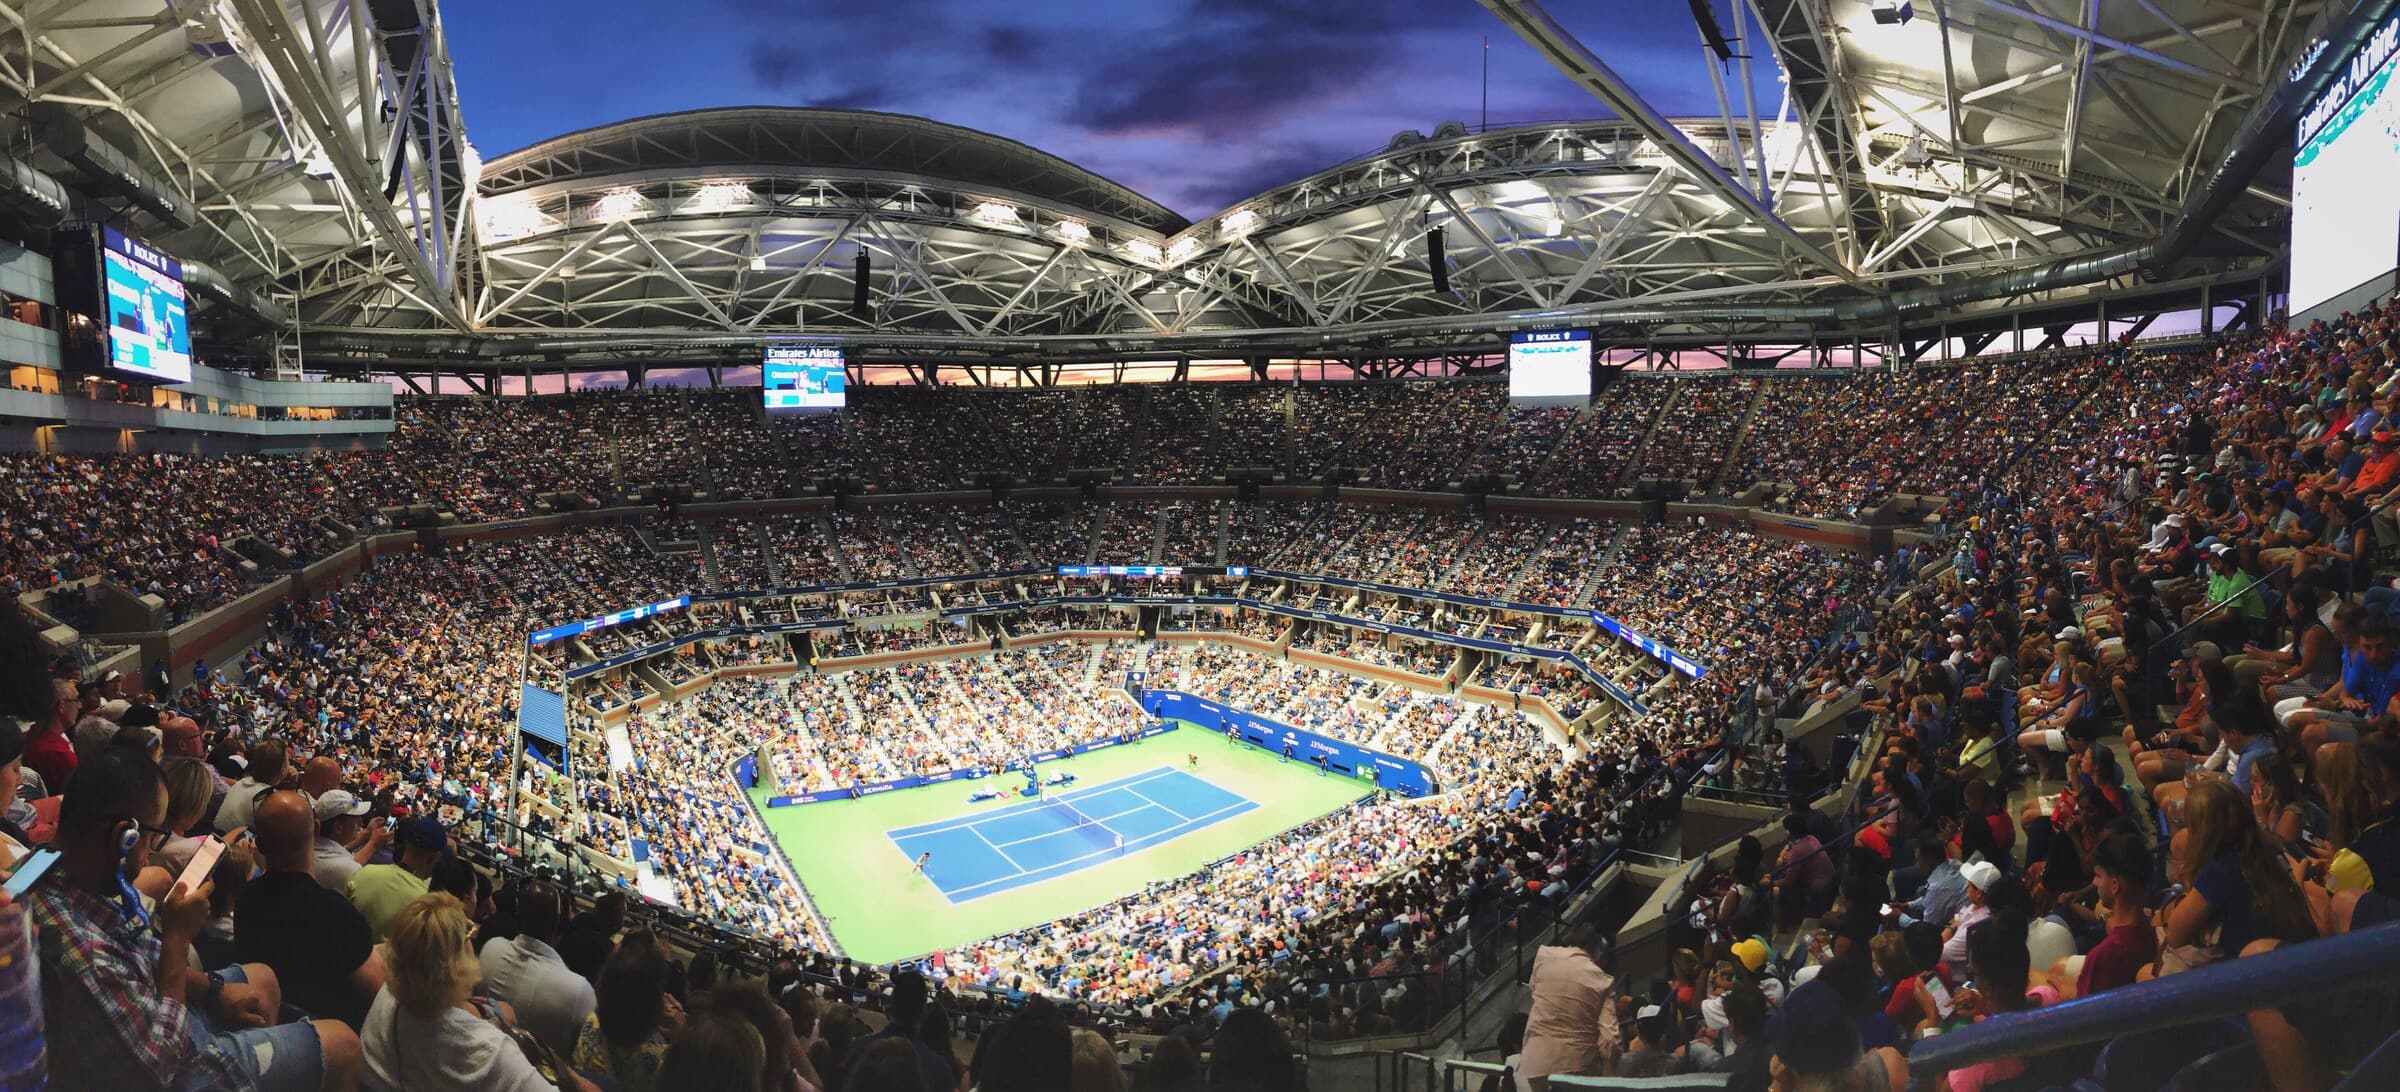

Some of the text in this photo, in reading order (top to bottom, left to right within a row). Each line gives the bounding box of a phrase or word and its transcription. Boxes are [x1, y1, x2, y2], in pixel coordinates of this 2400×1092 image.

[2298, 17, 2399, 148] Emirates Airline
[133, 244, 160, 267] ROLEX
[767, 348, 840, 358] Emirates Airline
[863, 784, 895, 794] BERMUDA
